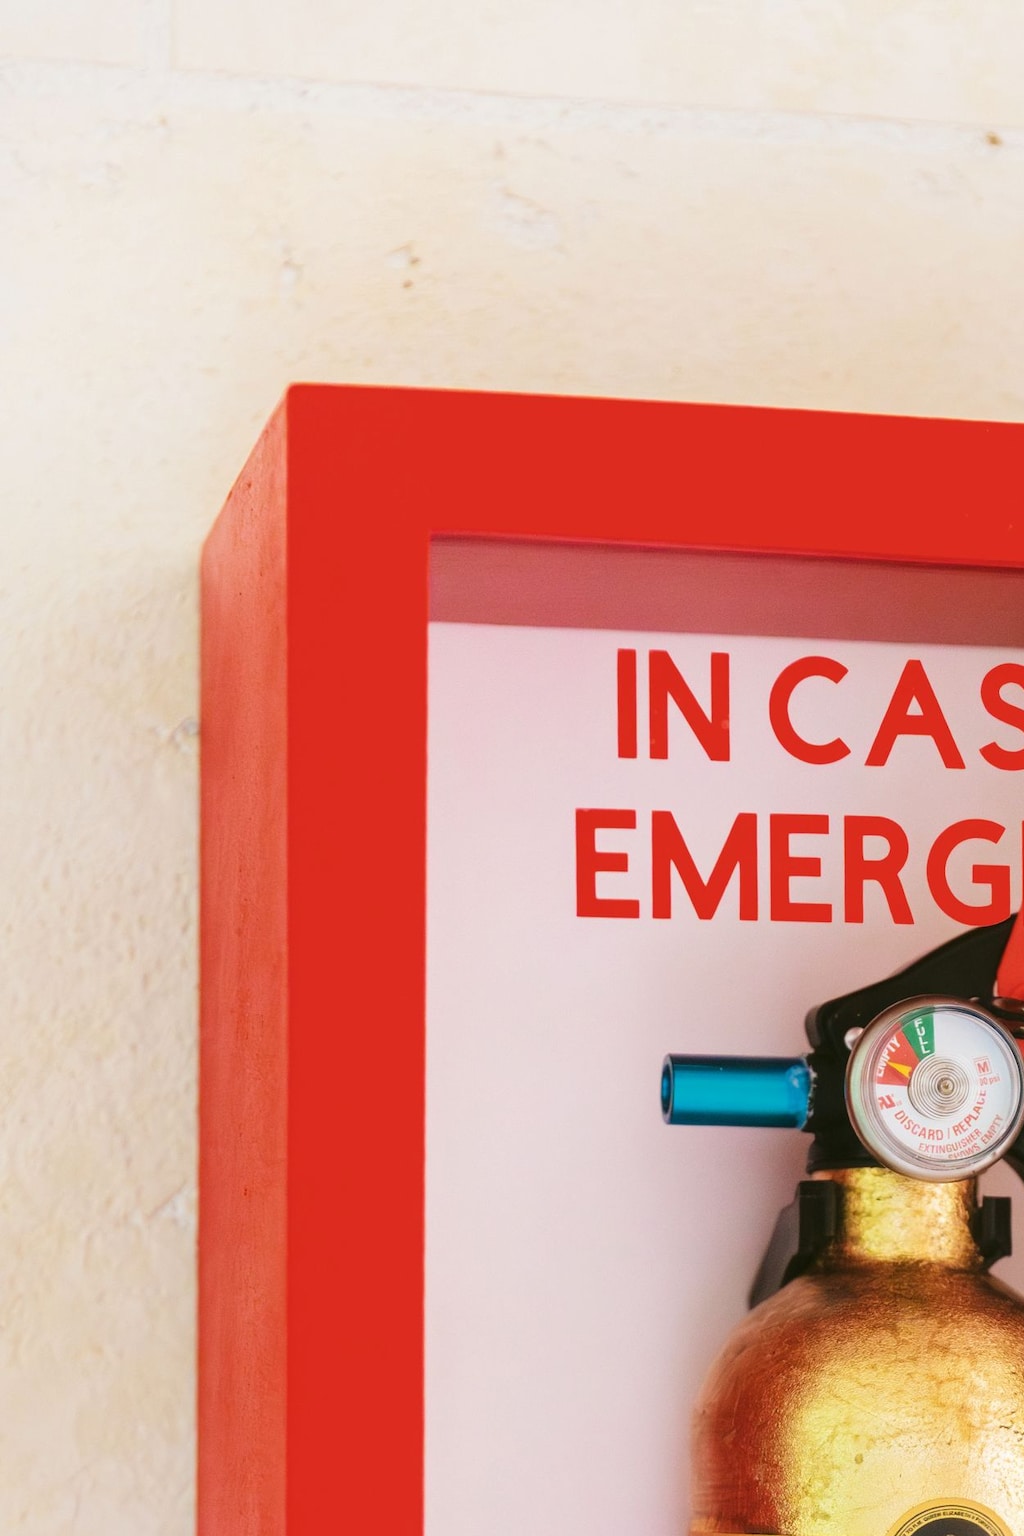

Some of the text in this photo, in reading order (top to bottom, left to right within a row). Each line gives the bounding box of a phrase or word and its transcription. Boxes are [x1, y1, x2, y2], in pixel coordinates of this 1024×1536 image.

[616, 648, 730, 762] IN
[877, 1034, 901, 1078] EMPTY
[913, 1017, 931, 1055] FULL
[893, 1110, 944, 1141] DISCARD
[951, 1089, 987, 1137] REPLACE
[980, 1113, 1004, 1145] EMPTY
[918, 1128, 982, 1154] EXTINGUISHER
